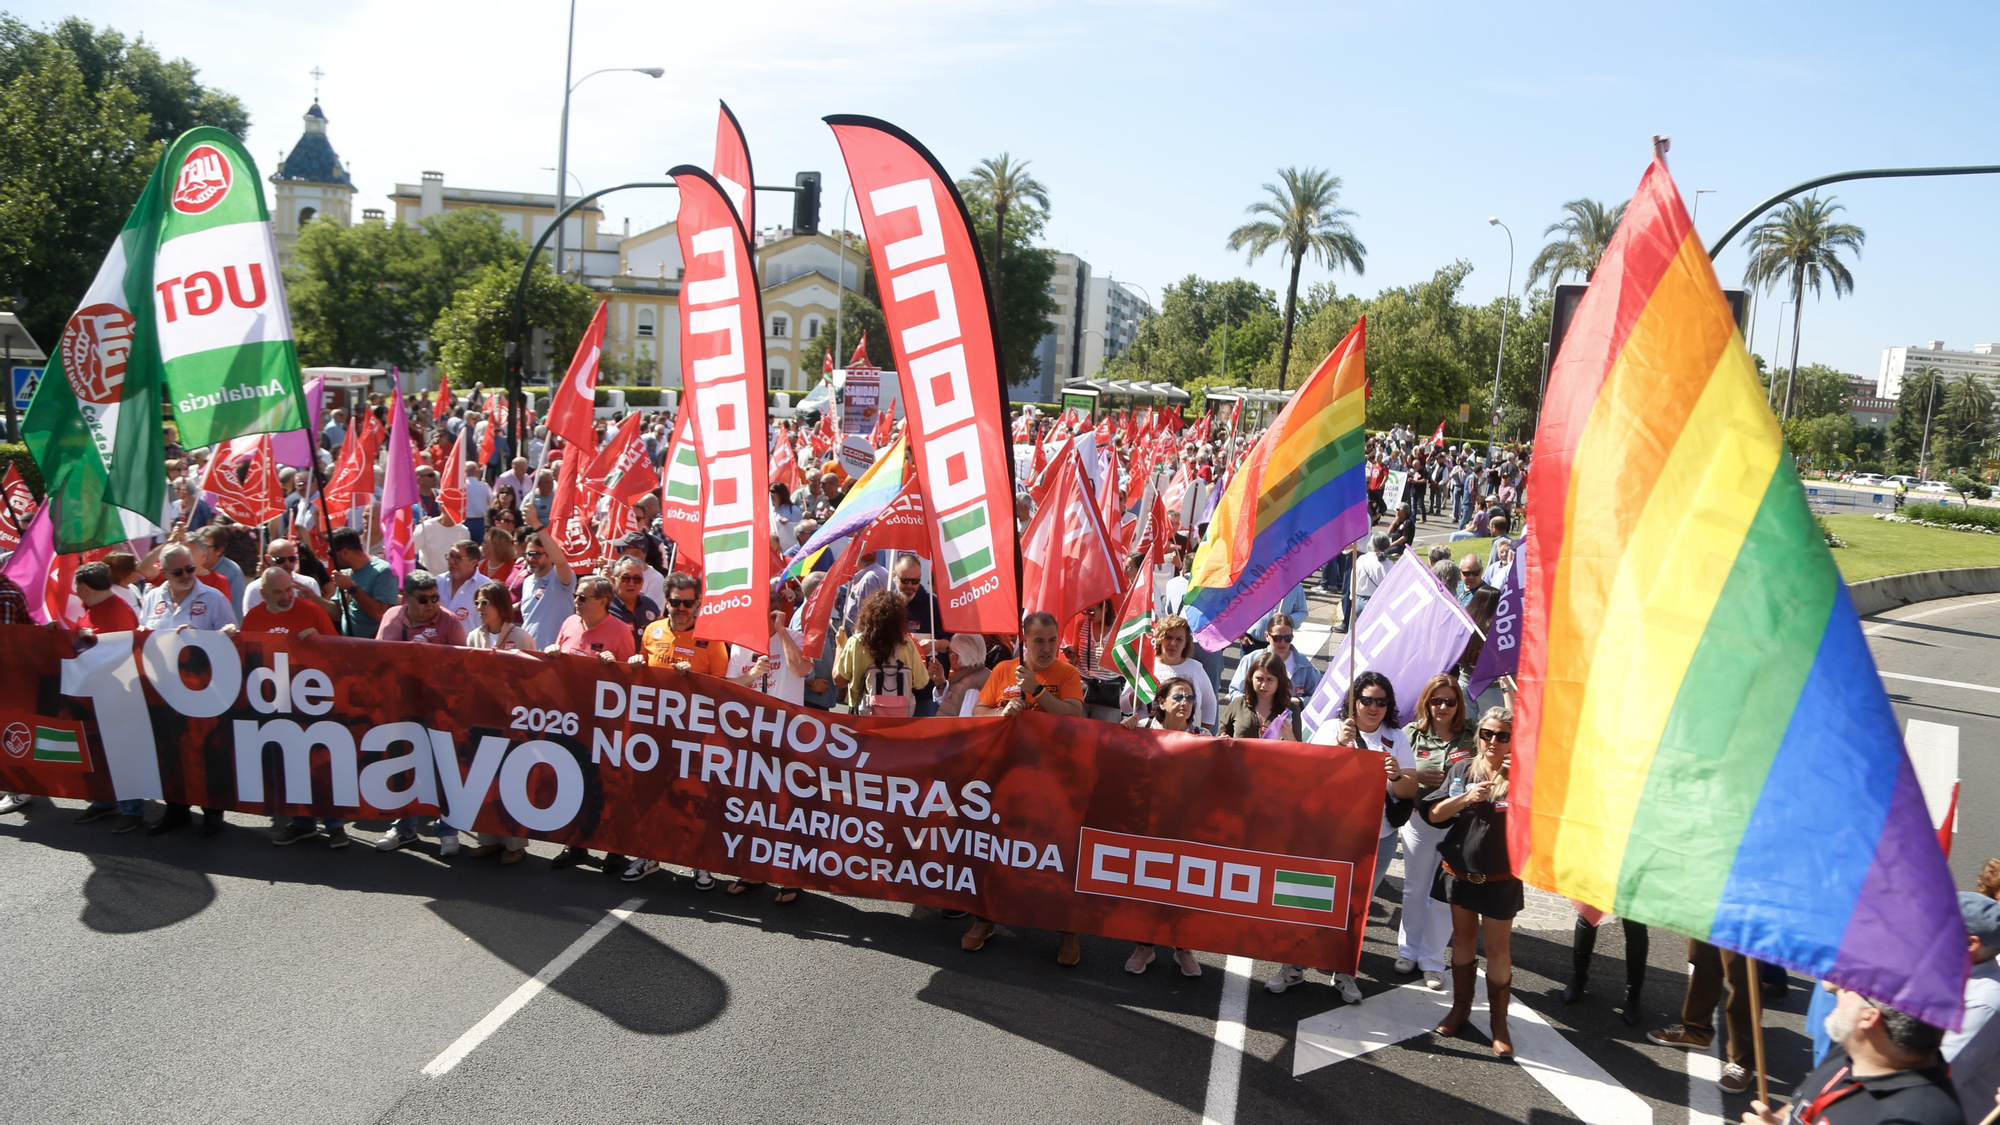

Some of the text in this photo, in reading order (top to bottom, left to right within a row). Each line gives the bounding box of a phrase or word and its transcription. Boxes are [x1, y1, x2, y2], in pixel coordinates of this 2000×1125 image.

[845, 385, 879, 397] SANIDAD
[846, 369, 880, 378] CCOO
[844, 447, 864, 459] CCOO
[247, 652, 334, 715] de
[510, 706, 579, 736] 2026
[595, 680, 871, 768] DERECHOS,
[233, 719, 585, 832] mayo
[592, 727, 1001, 824] NO TRINCHERAS.
[722, 832, 977, 895] Y DEMOCRACIA
[724, 797, 1065, 873] SALARIOS, VIVIENDA
[1091, 843, 1261, 904] CCOO
